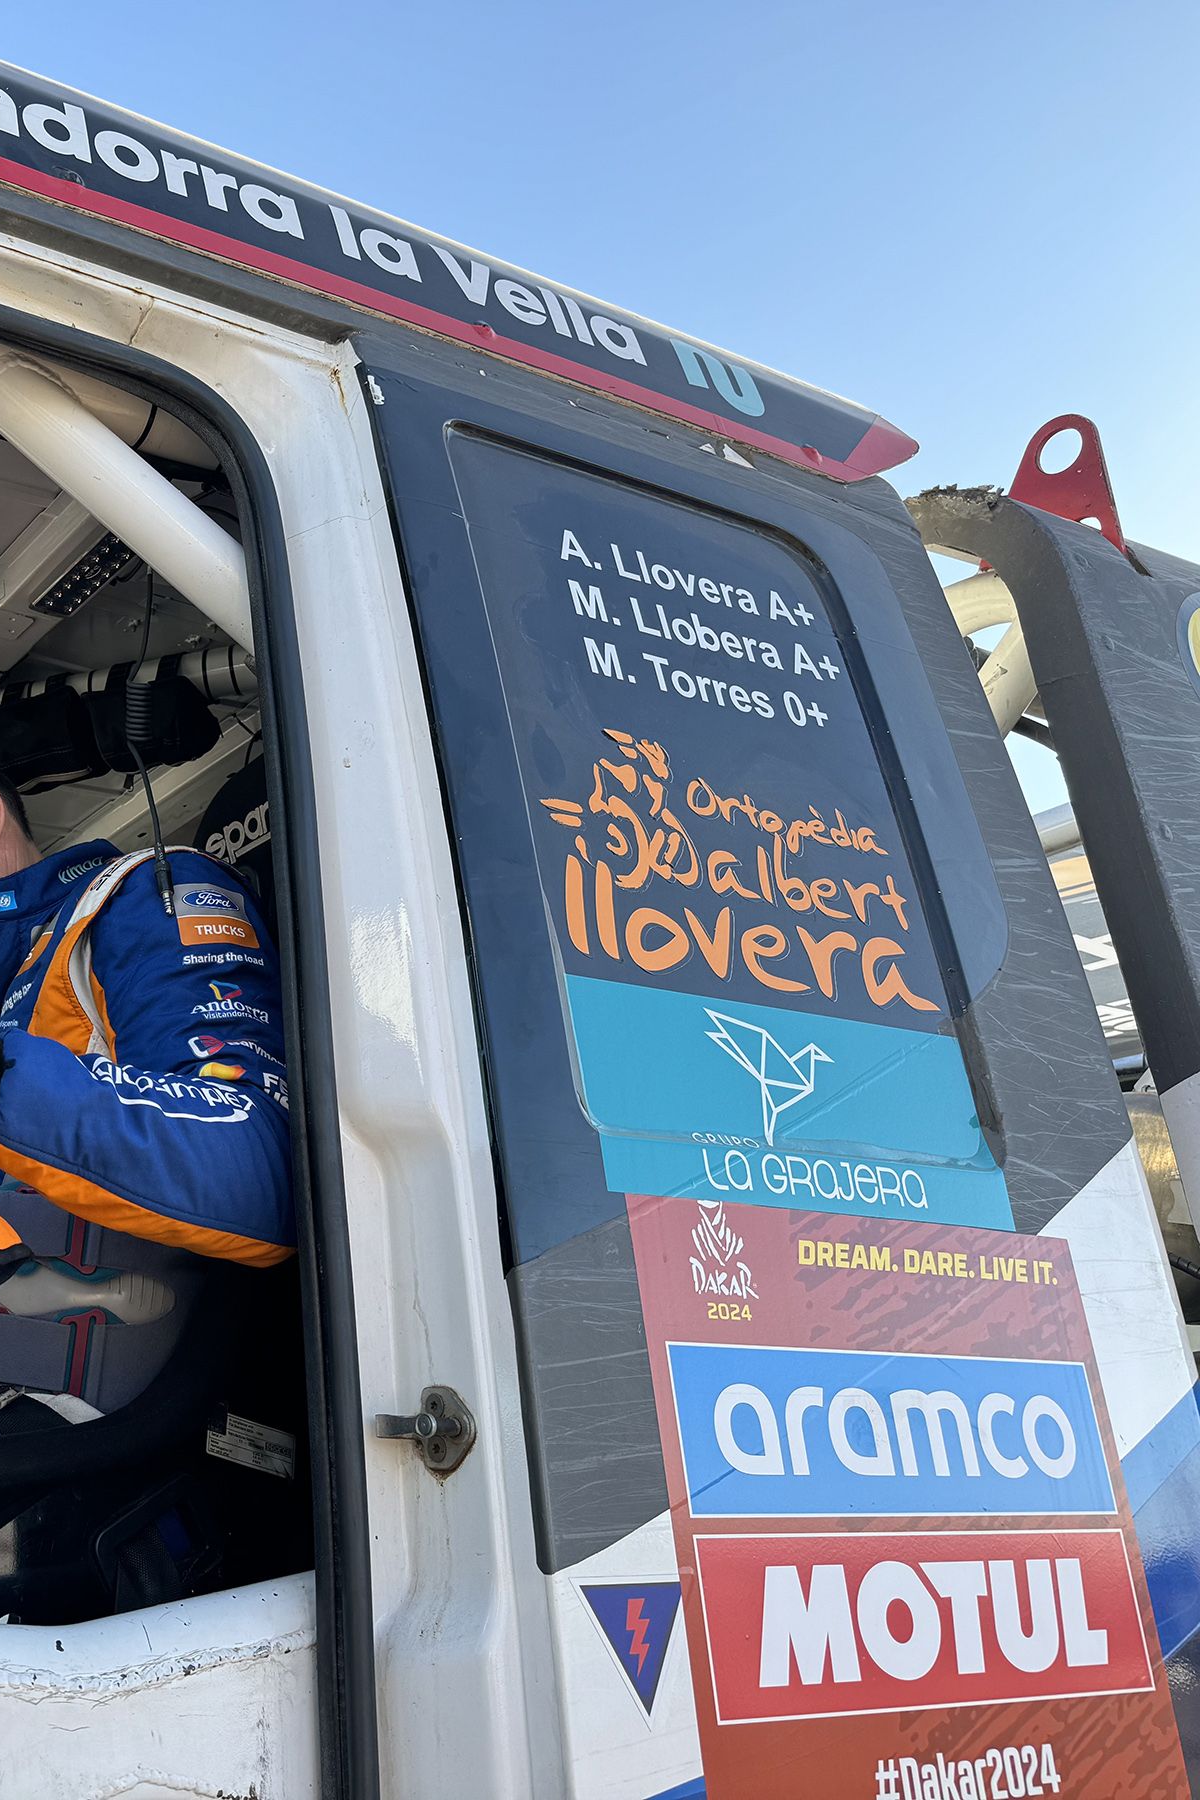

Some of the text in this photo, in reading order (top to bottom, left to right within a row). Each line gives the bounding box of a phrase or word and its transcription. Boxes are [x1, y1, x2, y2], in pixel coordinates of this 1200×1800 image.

[329, 203, 422, 283] la
[429, 243, 647, 366] Vella
[560, 529, 814, 627] A. Llovera A+
[567, 579, 840, 682] M. Llobera A+
[583, 637, 636, 683] M.
[643, 652, 775, 720] Torres
[195, 891, 231, 908] Ford
[706, 832, 909, 931] albert
[182, 951, 264, 966] Sharing the load
[194, 924, 246, 938] TRUCKS
[564, 853, 942, 1012] llovera
[190, 998, 269, 1024] Andorra
[689, 1256, 759, 1300] DAKAR
[798, 1240, 1059, 1286] DREAM. DARE. LIVE IT.
[707, 1302, 753, 1321] 2024
[713, 1382, 1077, 1479] aramco
[759, 1557, 1109, 1688] MOTUL
[875, 1743, 1062, 1800] #Dakar2024
